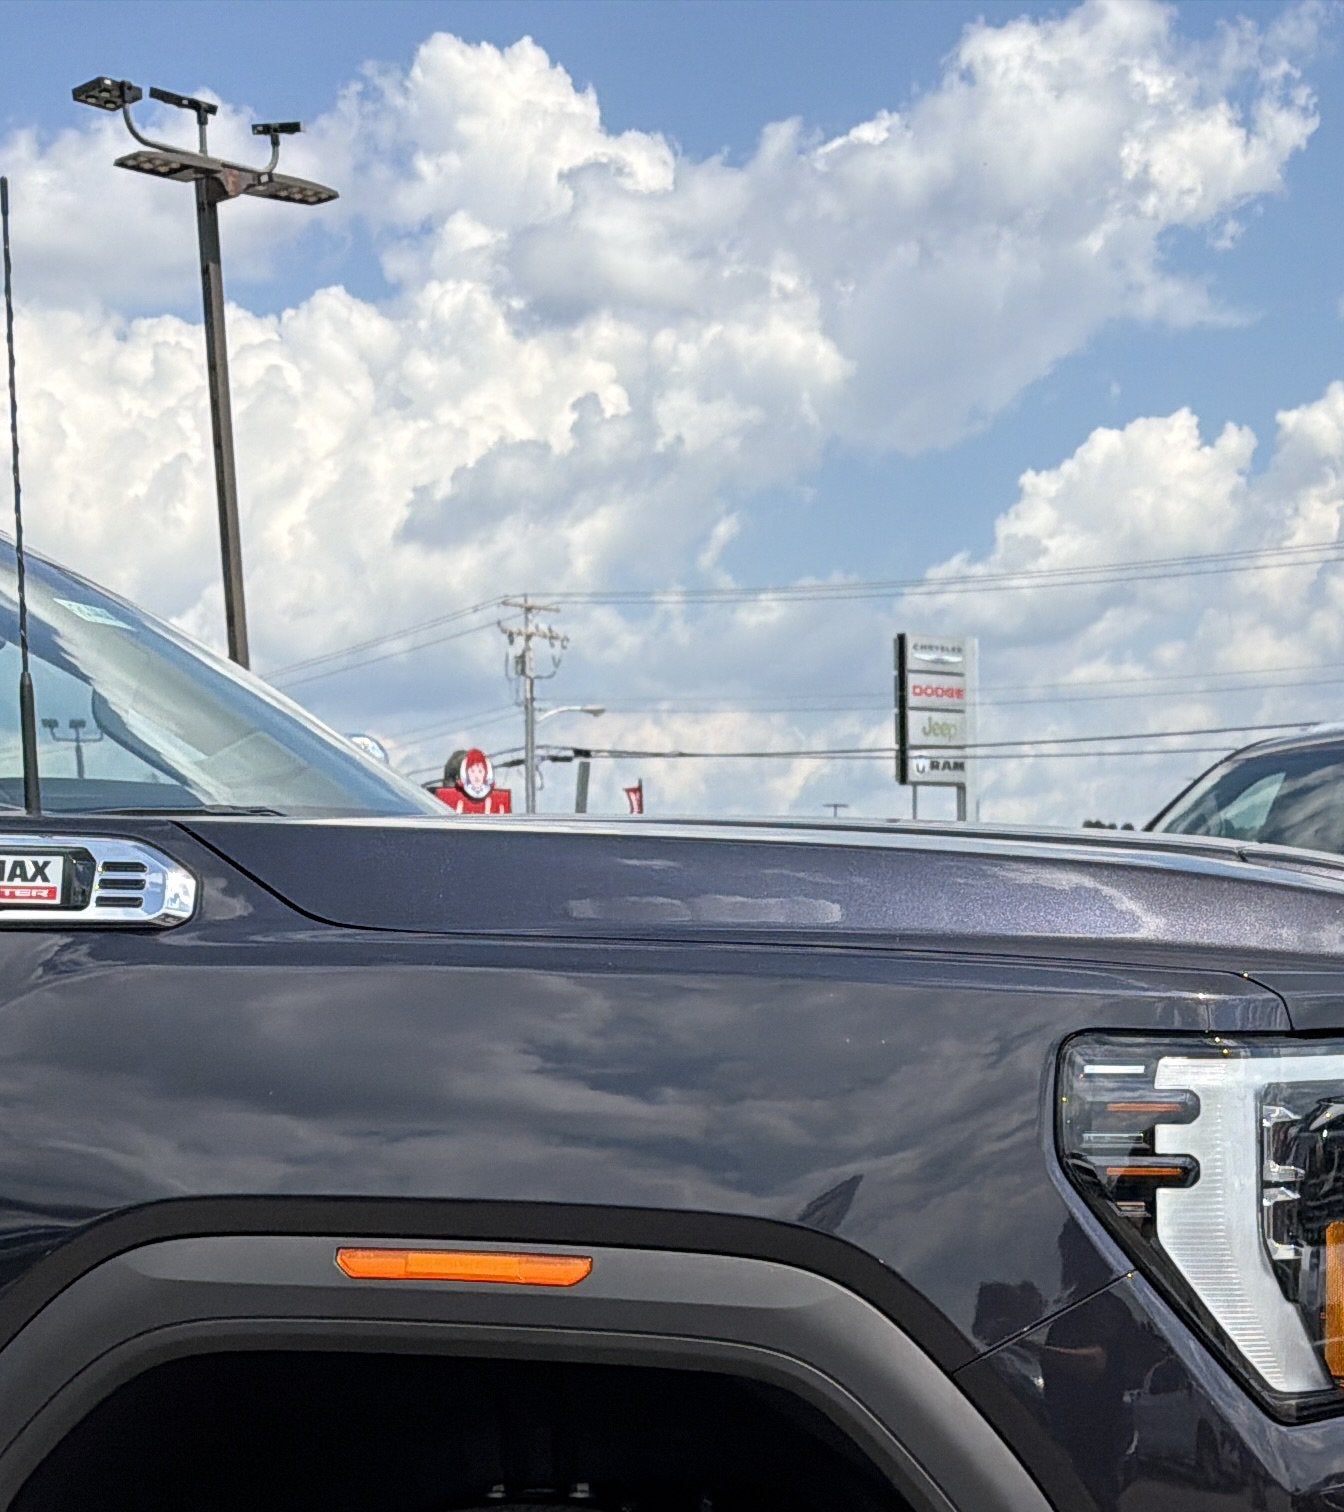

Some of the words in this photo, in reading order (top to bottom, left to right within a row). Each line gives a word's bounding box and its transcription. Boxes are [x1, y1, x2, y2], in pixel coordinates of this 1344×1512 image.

[912, 685, 964, 699] DODGE
[922, 716, 956, 742] Jeep
[930, 760, 965, 772] RAM
